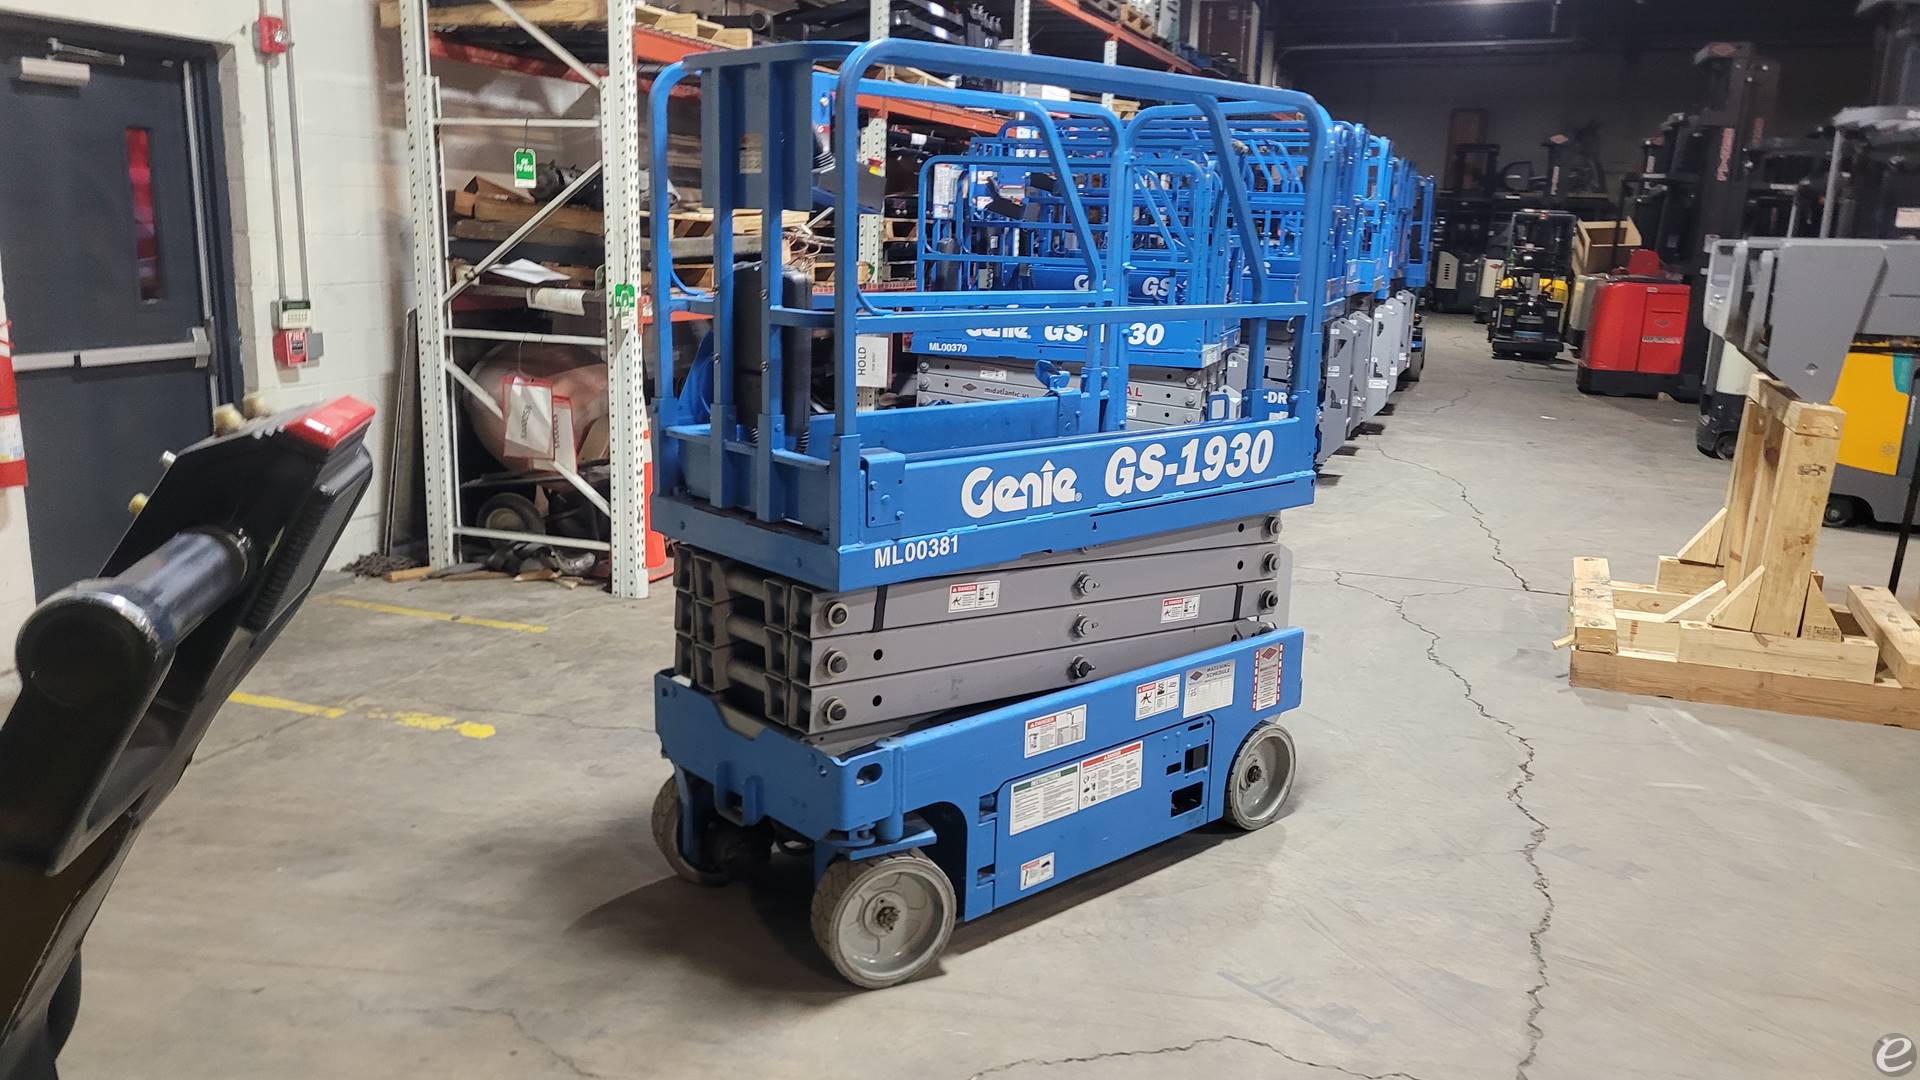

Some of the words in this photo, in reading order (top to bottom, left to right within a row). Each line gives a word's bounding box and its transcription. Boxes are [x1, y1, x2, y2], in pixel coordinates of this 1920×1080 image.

[858, 346, 867, 375] HOLD
[928, 341, 968, 353] ML00379
[961, 460, 1078, 518] Genie
[1104, 430, 1274, 497] GS-1930
[874, 534, 959, 569] ML00381
